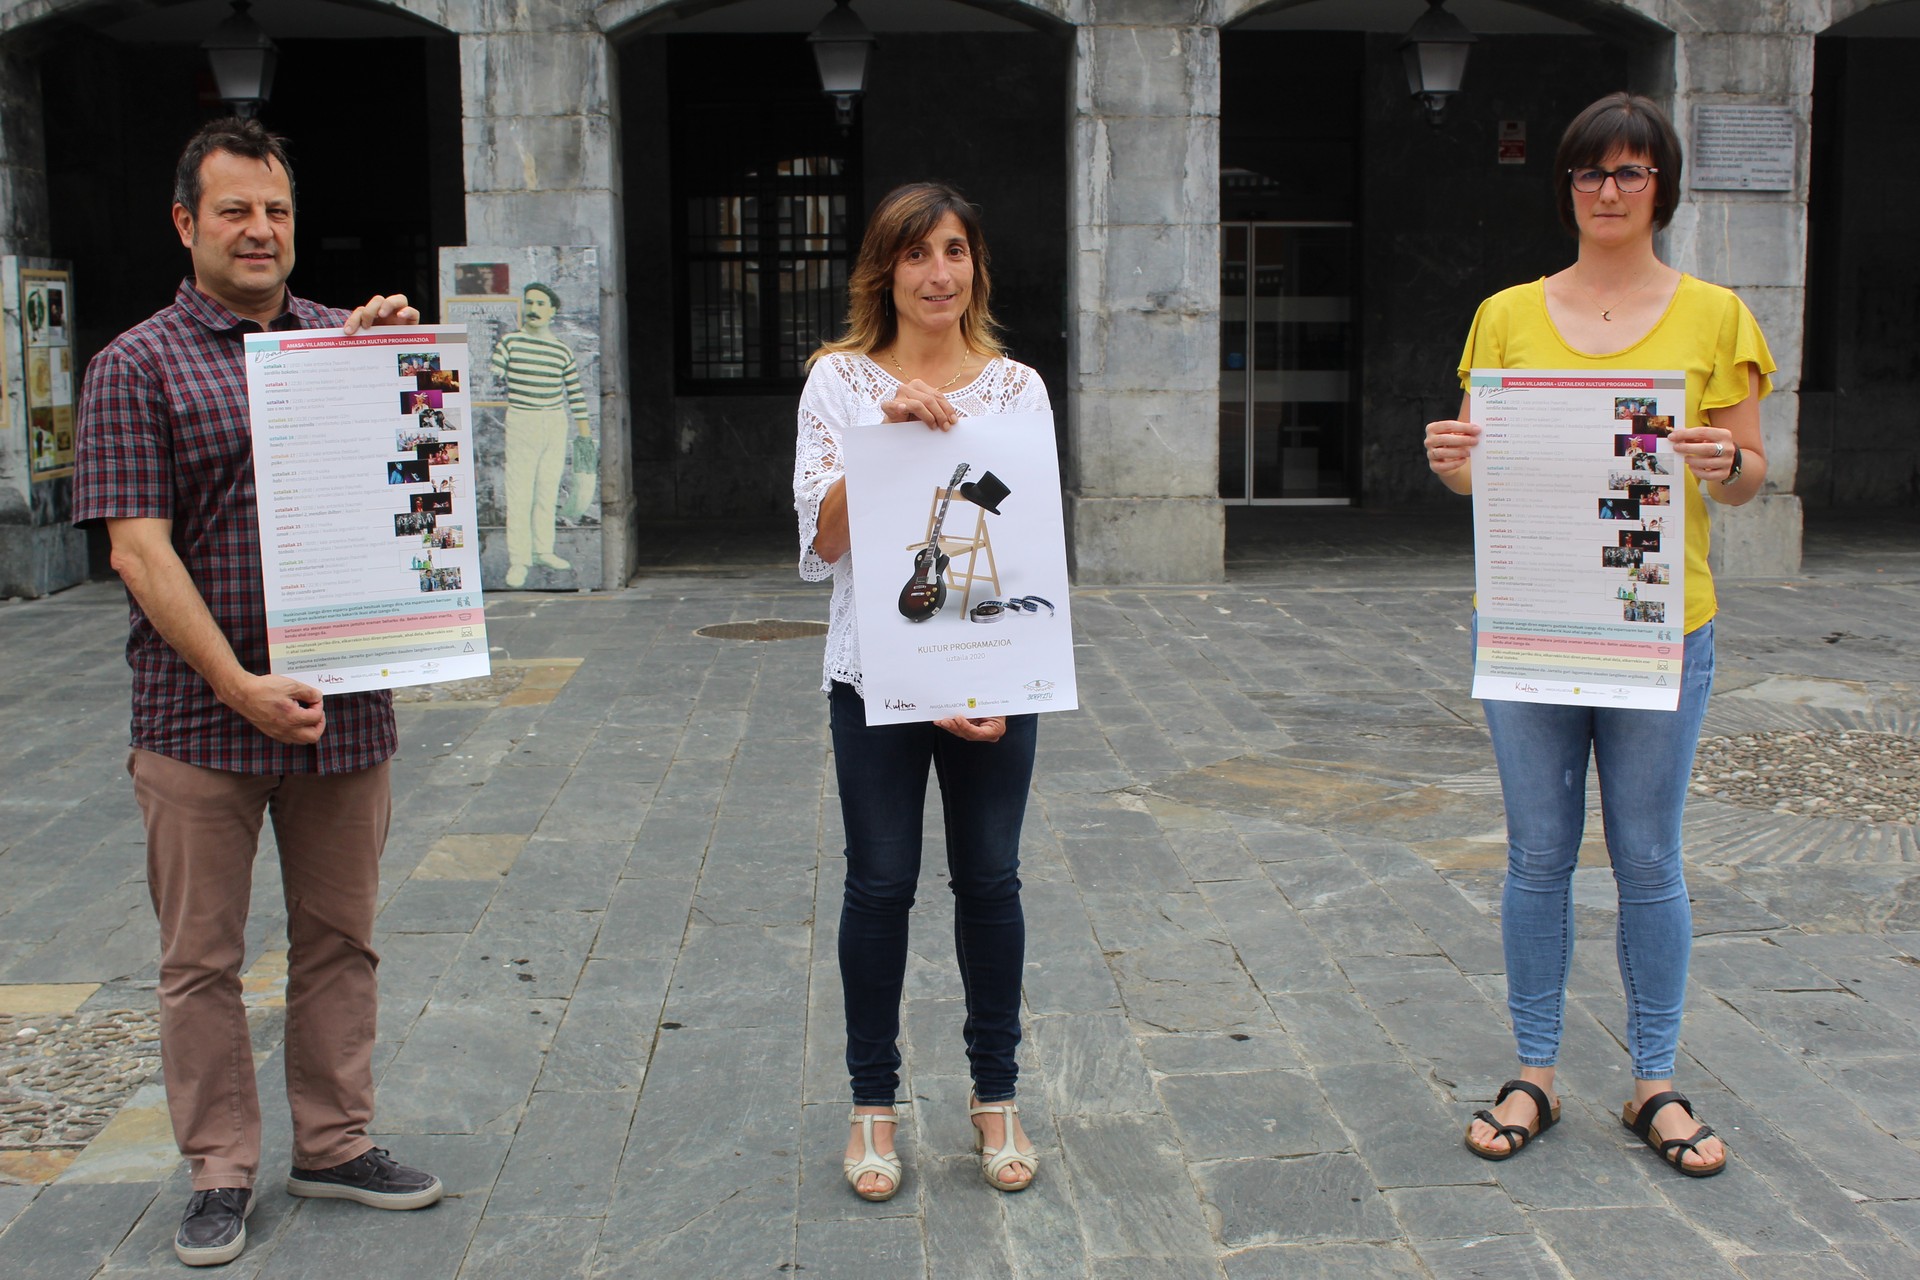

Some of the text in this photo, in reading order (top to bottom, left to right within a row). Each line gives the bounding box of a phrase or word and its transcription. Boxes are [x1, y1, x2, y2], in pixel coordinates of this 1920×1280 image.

[286, 341, 335, 349] AMASA-VILLABONA
[388, 336, 430, 344] PROGRAMAZIOA
[917, 638, 1012, 654] KULTUR PROGRAMAZIOA
[946, 652, 986, 663] uztaila 2020
[885, 698, 916, 710] Kultura
